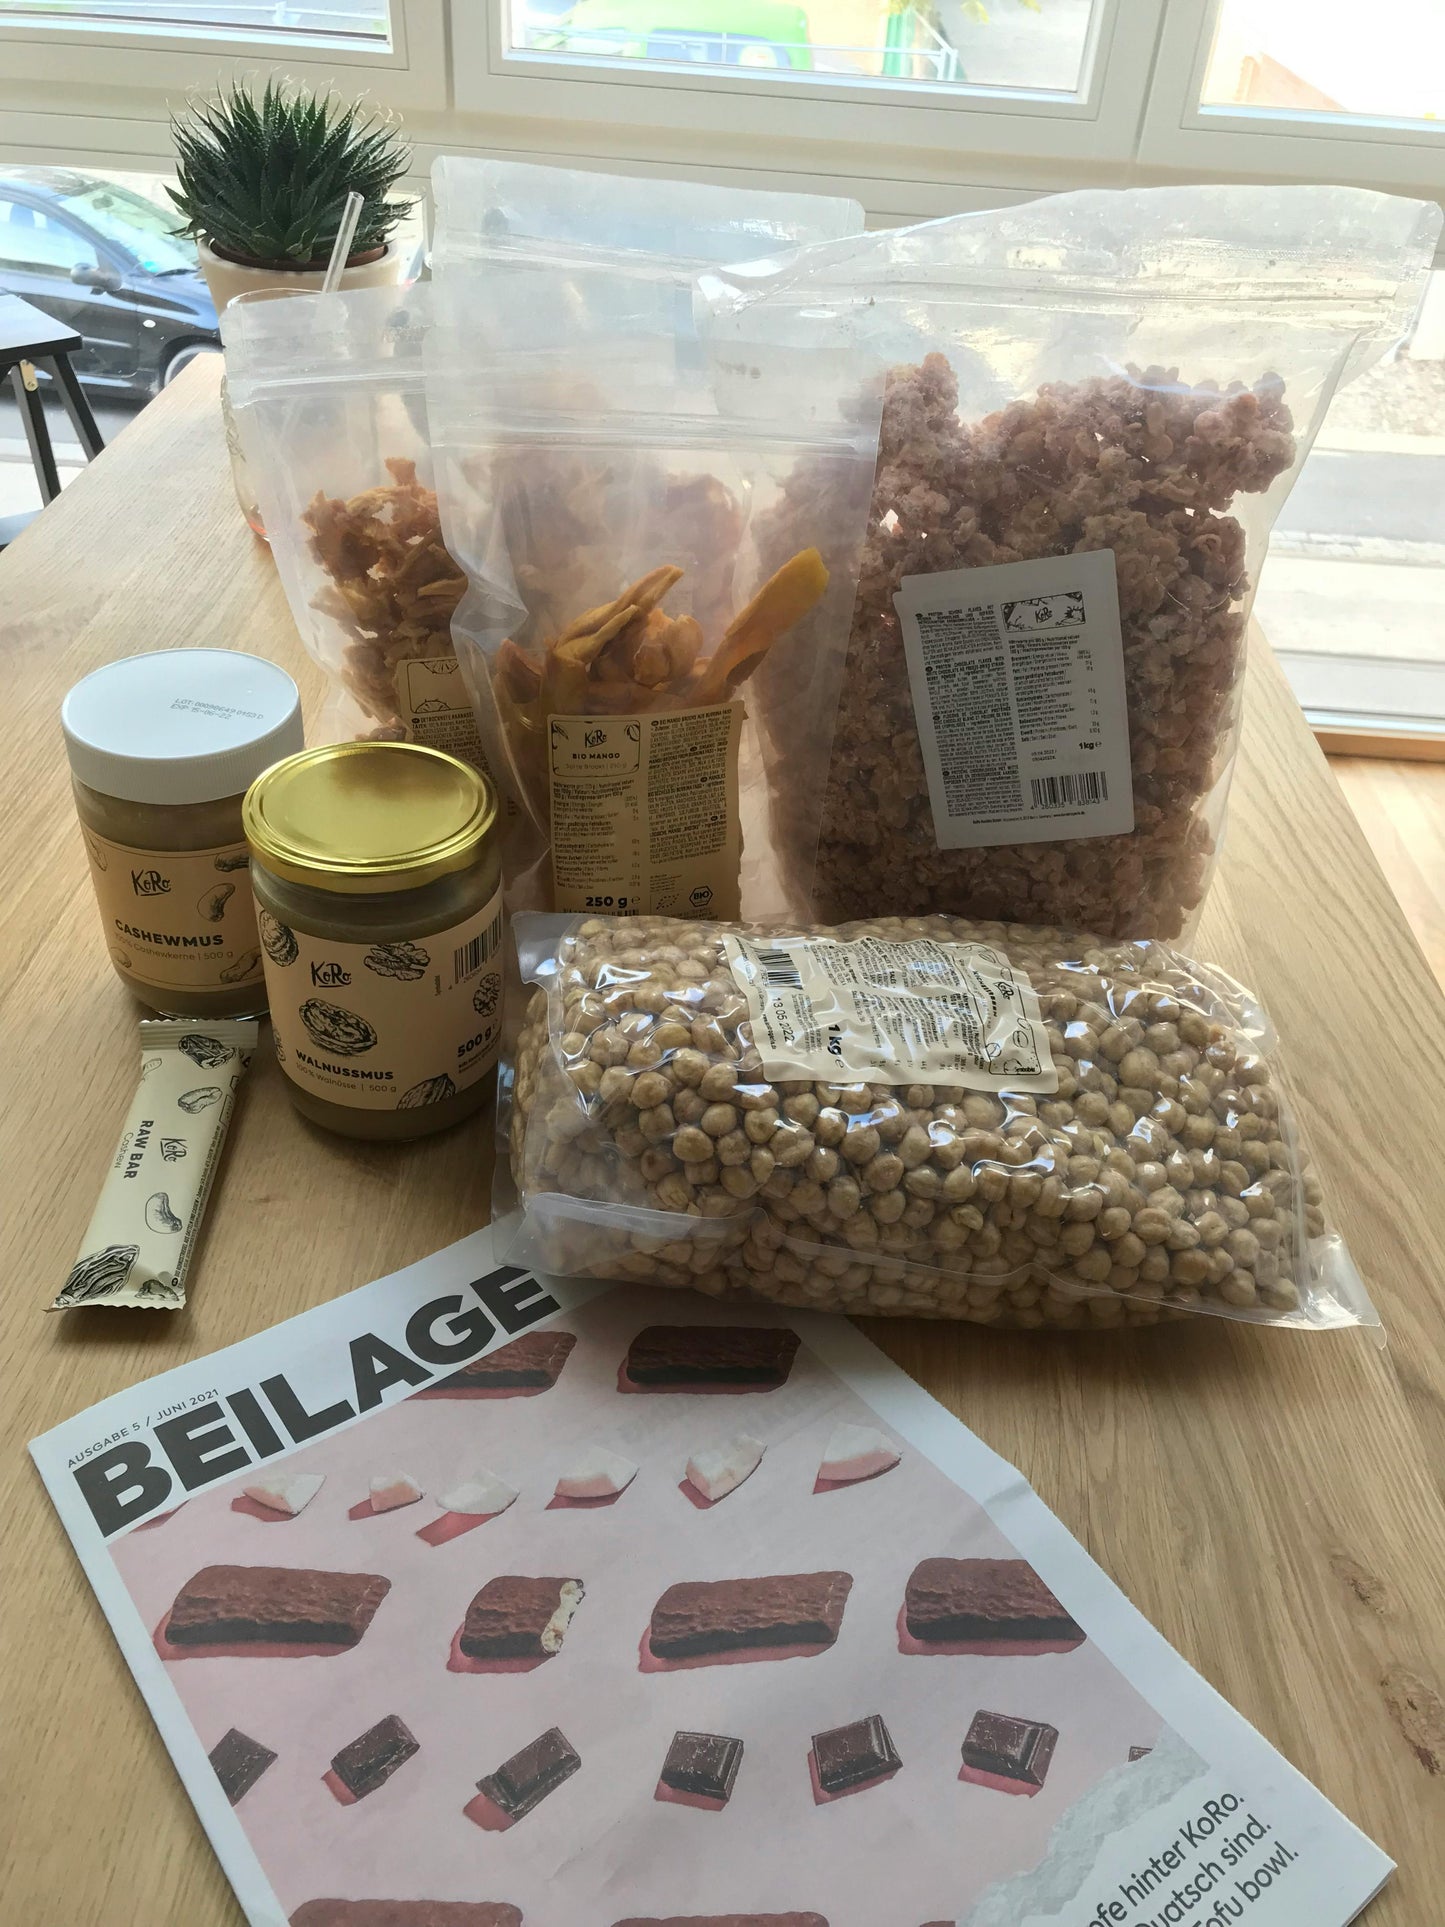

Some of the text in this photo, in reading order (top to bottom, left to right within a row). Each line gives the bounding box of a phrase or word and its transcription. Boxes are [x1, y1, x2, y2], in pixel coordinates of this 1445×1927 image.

[584, 729, 608, 748] KoRo
[1083, 742, 1095, 750] kg
[572, 752, 621, 760] BIO MANGO
[130, 869, 172, 897] KoRo
[693, 890, 710, 900] BIO
[585, 895, 628, 909] 250 g
[115, 919, 224, 947] CASHEWMUS
[133, 943, 196, 961] Cashewkerne
[203, 951, 224, 960] 500
[310, 961, 352, 988] KoRo
[457, 1033, 483, 1058] 500
[827, 1024, 842, 1056] 1 kg
[295, 1049, 394, 1080] WALNUSSMUS
[316, 1073, 357, 1090] Walnüsse
[369, 1084, 388, 1092] 500
[122, 1119, 155, 1180] RAW BAR
[160, 1137, 189, 1163] KoRo
[73, 1264, 562, 1538] BEILAGE
[67, 1427, 130, 1468] AUSGABE
[132, 1422, 141, 1432] 5
[156, 1401, 187, 1421] JUNI
[189, 1388, 220, 1406] 2021
[1118, 1839, 1186, 1908] hinter
[1178, 1789, 1246, 1849] KoRo.
[1220, 1812, 1272, 1868] sind.
[1236, 1840, 1300, 1904] bowl.
